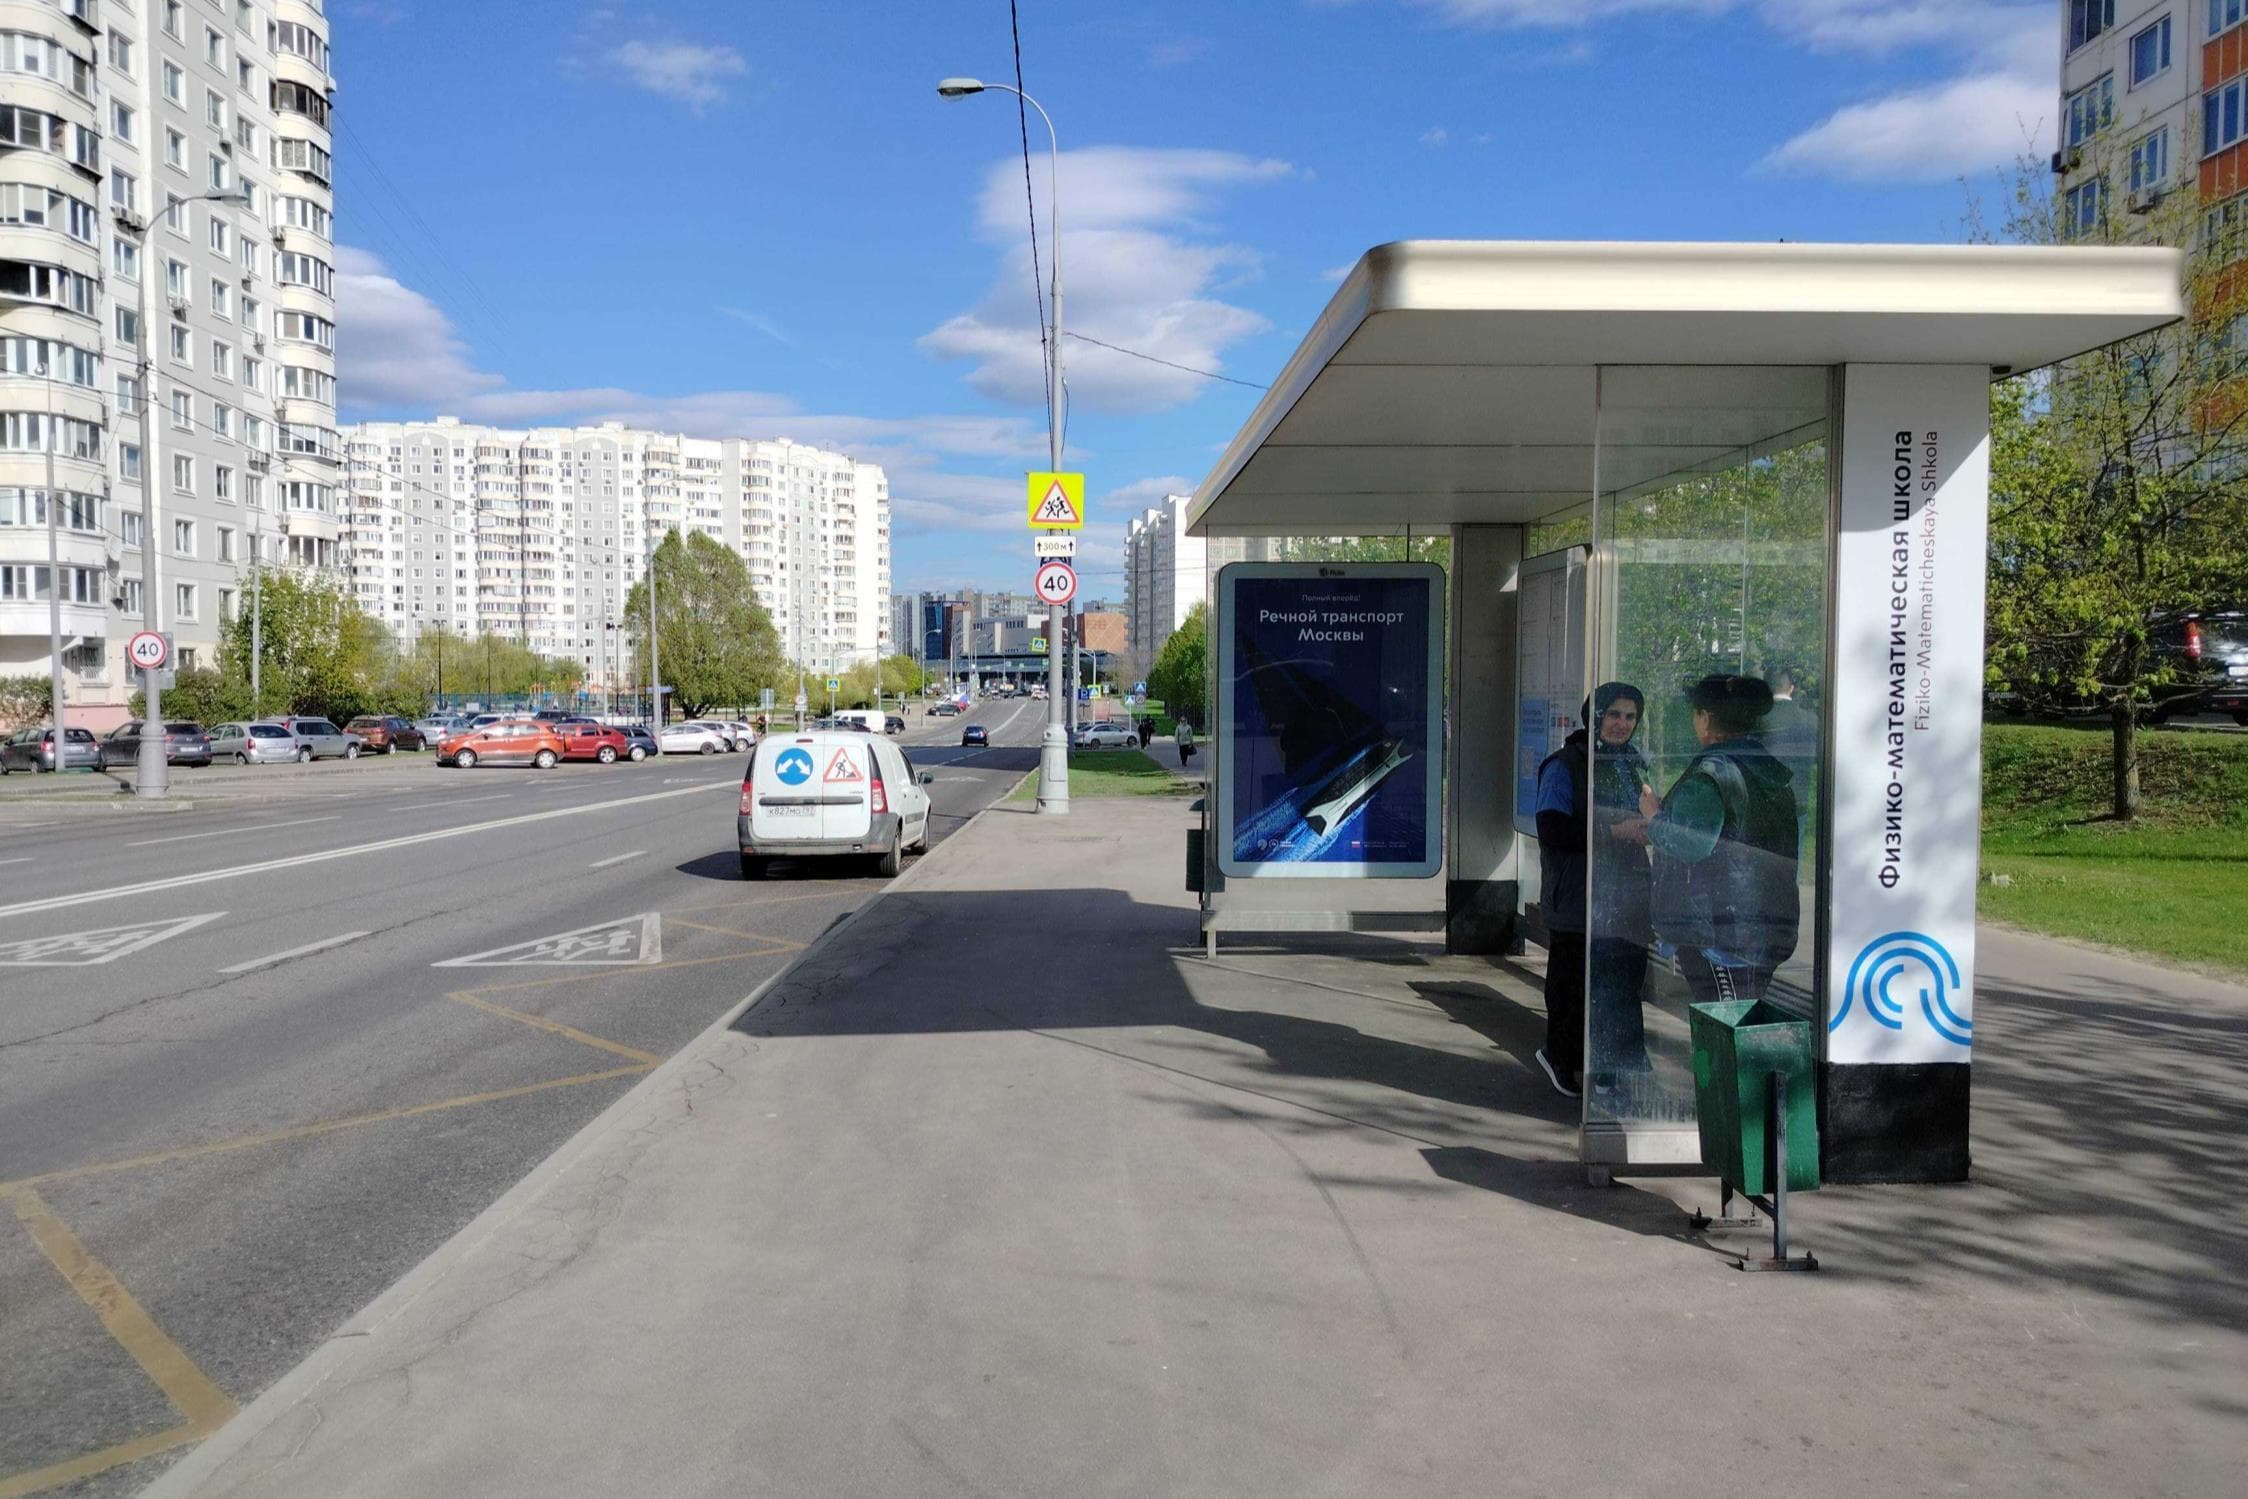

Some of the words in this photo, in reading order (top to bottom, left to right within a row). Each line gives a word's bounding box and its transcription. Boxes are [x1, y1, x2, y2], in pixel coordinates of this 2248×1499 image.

[1922, 431, 1938, 492] Shkola
[1892, 430, 1913, 520] школа
[1043, 541, 1067, 551] 300м
[1043, 575, 1068, 591] 40
[1260, 609, 1317, 623] Речной
[1322, 612, 1404, 625] транспорт
[1914, 494, 1938, 731] Fiziko-Matematicheskaya
[1298, 628, 1364, 642] Москвы
[137, 642, 159, 656] 40
[1878, 531, 1910, 889] Физико-математическая
